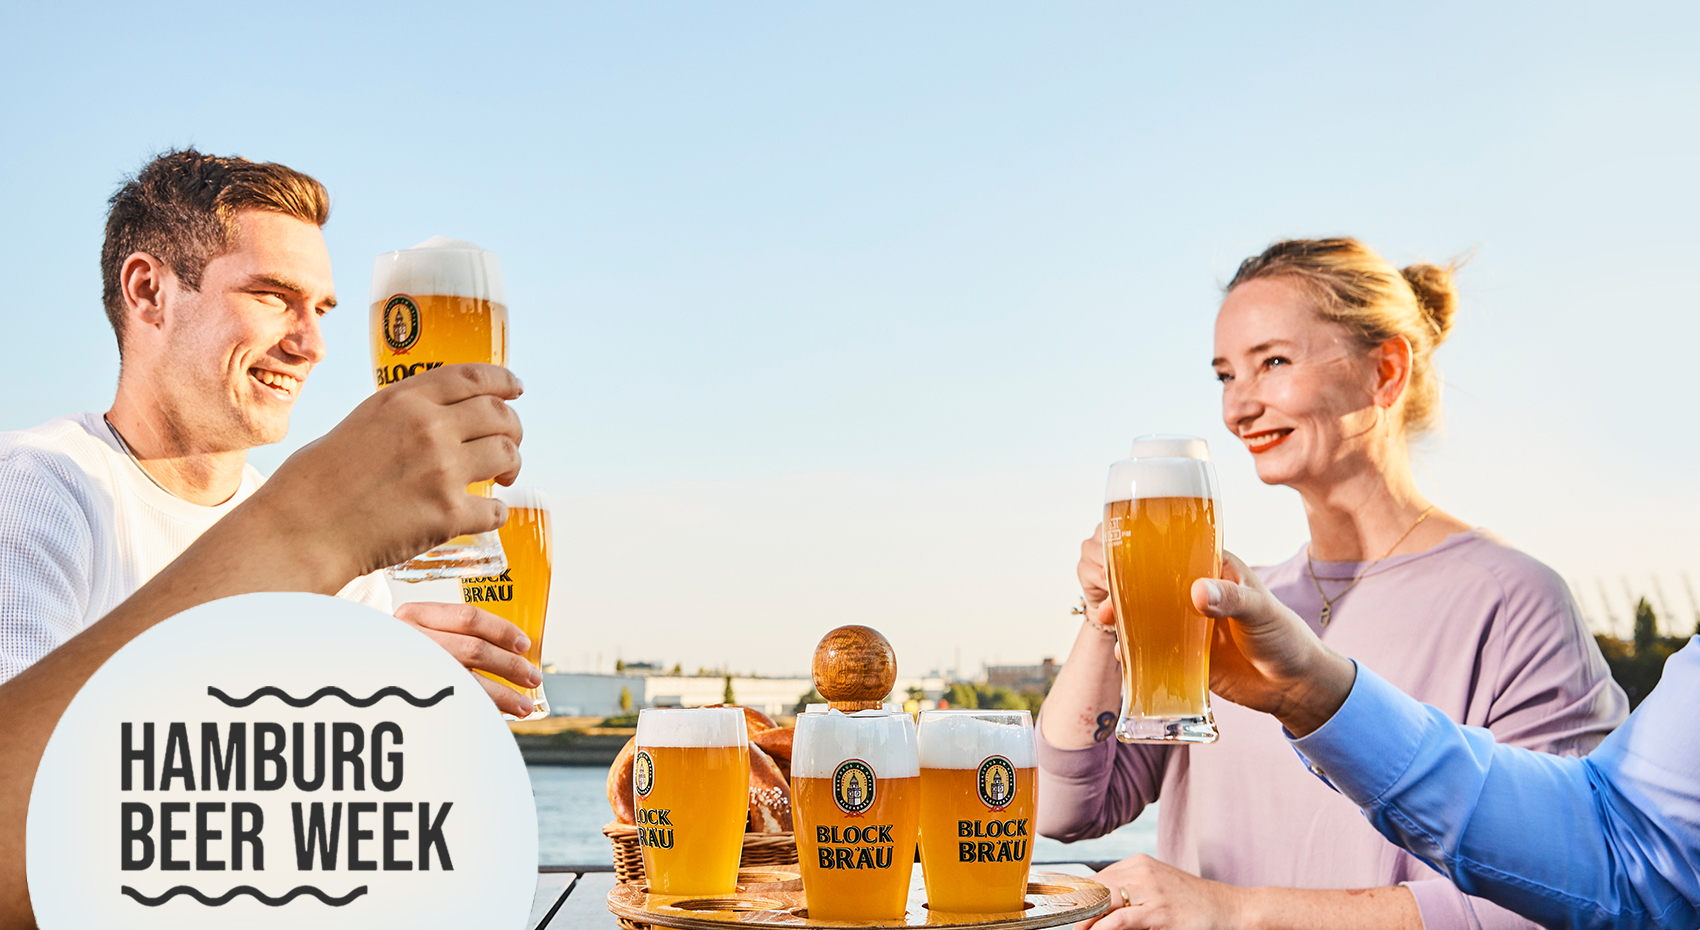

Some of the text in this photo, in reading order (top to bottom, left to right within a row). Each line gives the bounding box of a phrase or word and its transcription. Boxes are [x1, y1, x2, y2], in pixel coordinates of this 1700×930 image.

[463, 584, 513, 603] BRÄU
[816, 824, 894, 845] BLOCK
[958, 818, 1029, 839] BLOCK
[818, 846, 894, 870] BRÄU
[959, 838, 1028, 863] BRÄU
